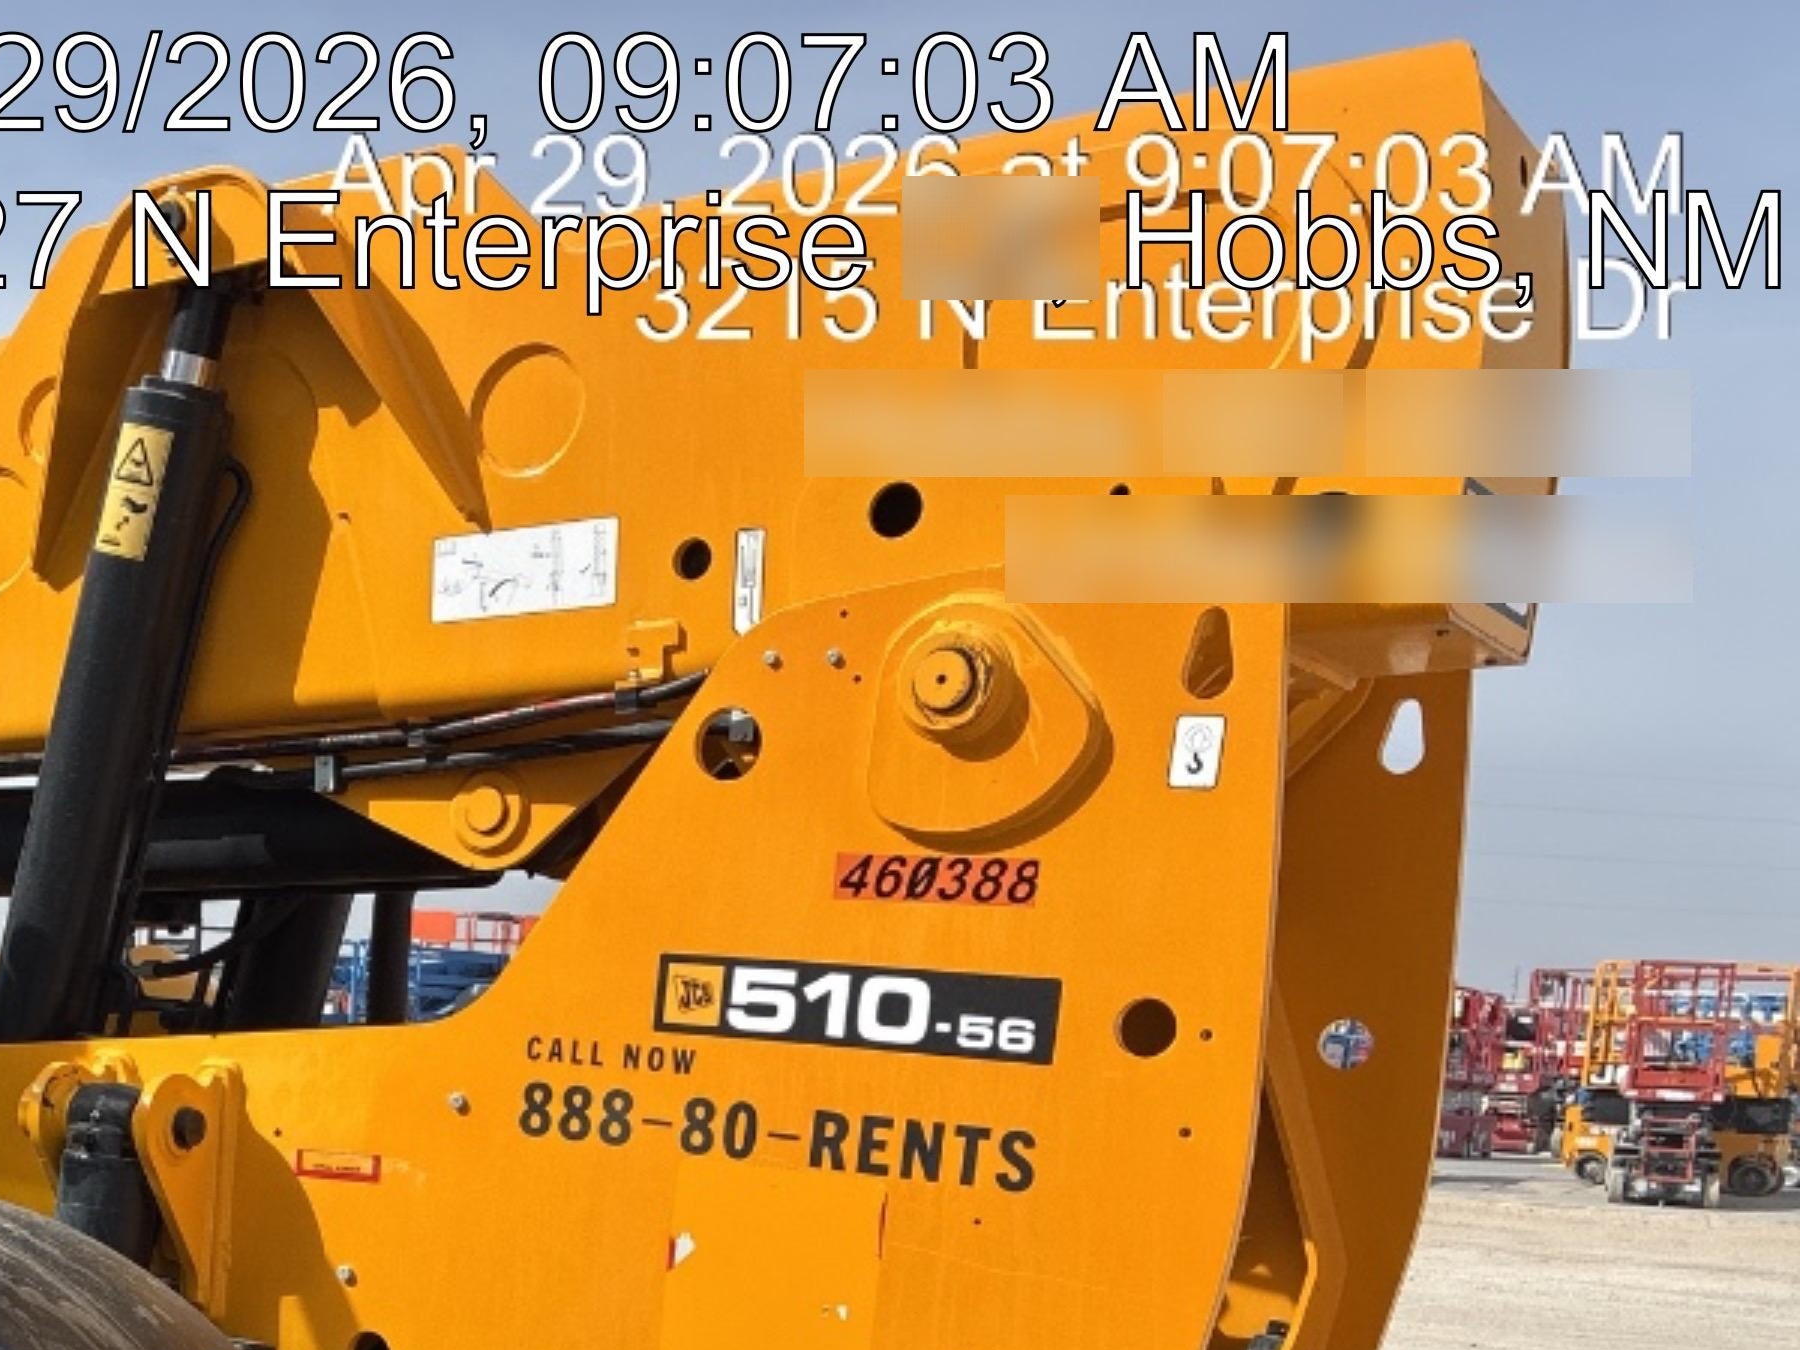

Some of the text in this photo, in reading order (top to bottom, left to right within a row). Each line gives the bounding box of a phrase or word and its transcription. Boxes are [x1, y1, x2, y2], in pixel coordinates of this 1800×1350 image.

[839, 854, 1040, 904] 460388
[527, 1036, 697, 1075] CALL NOW
[518, 1081, 1037, 1193] 888-80-RENTS
